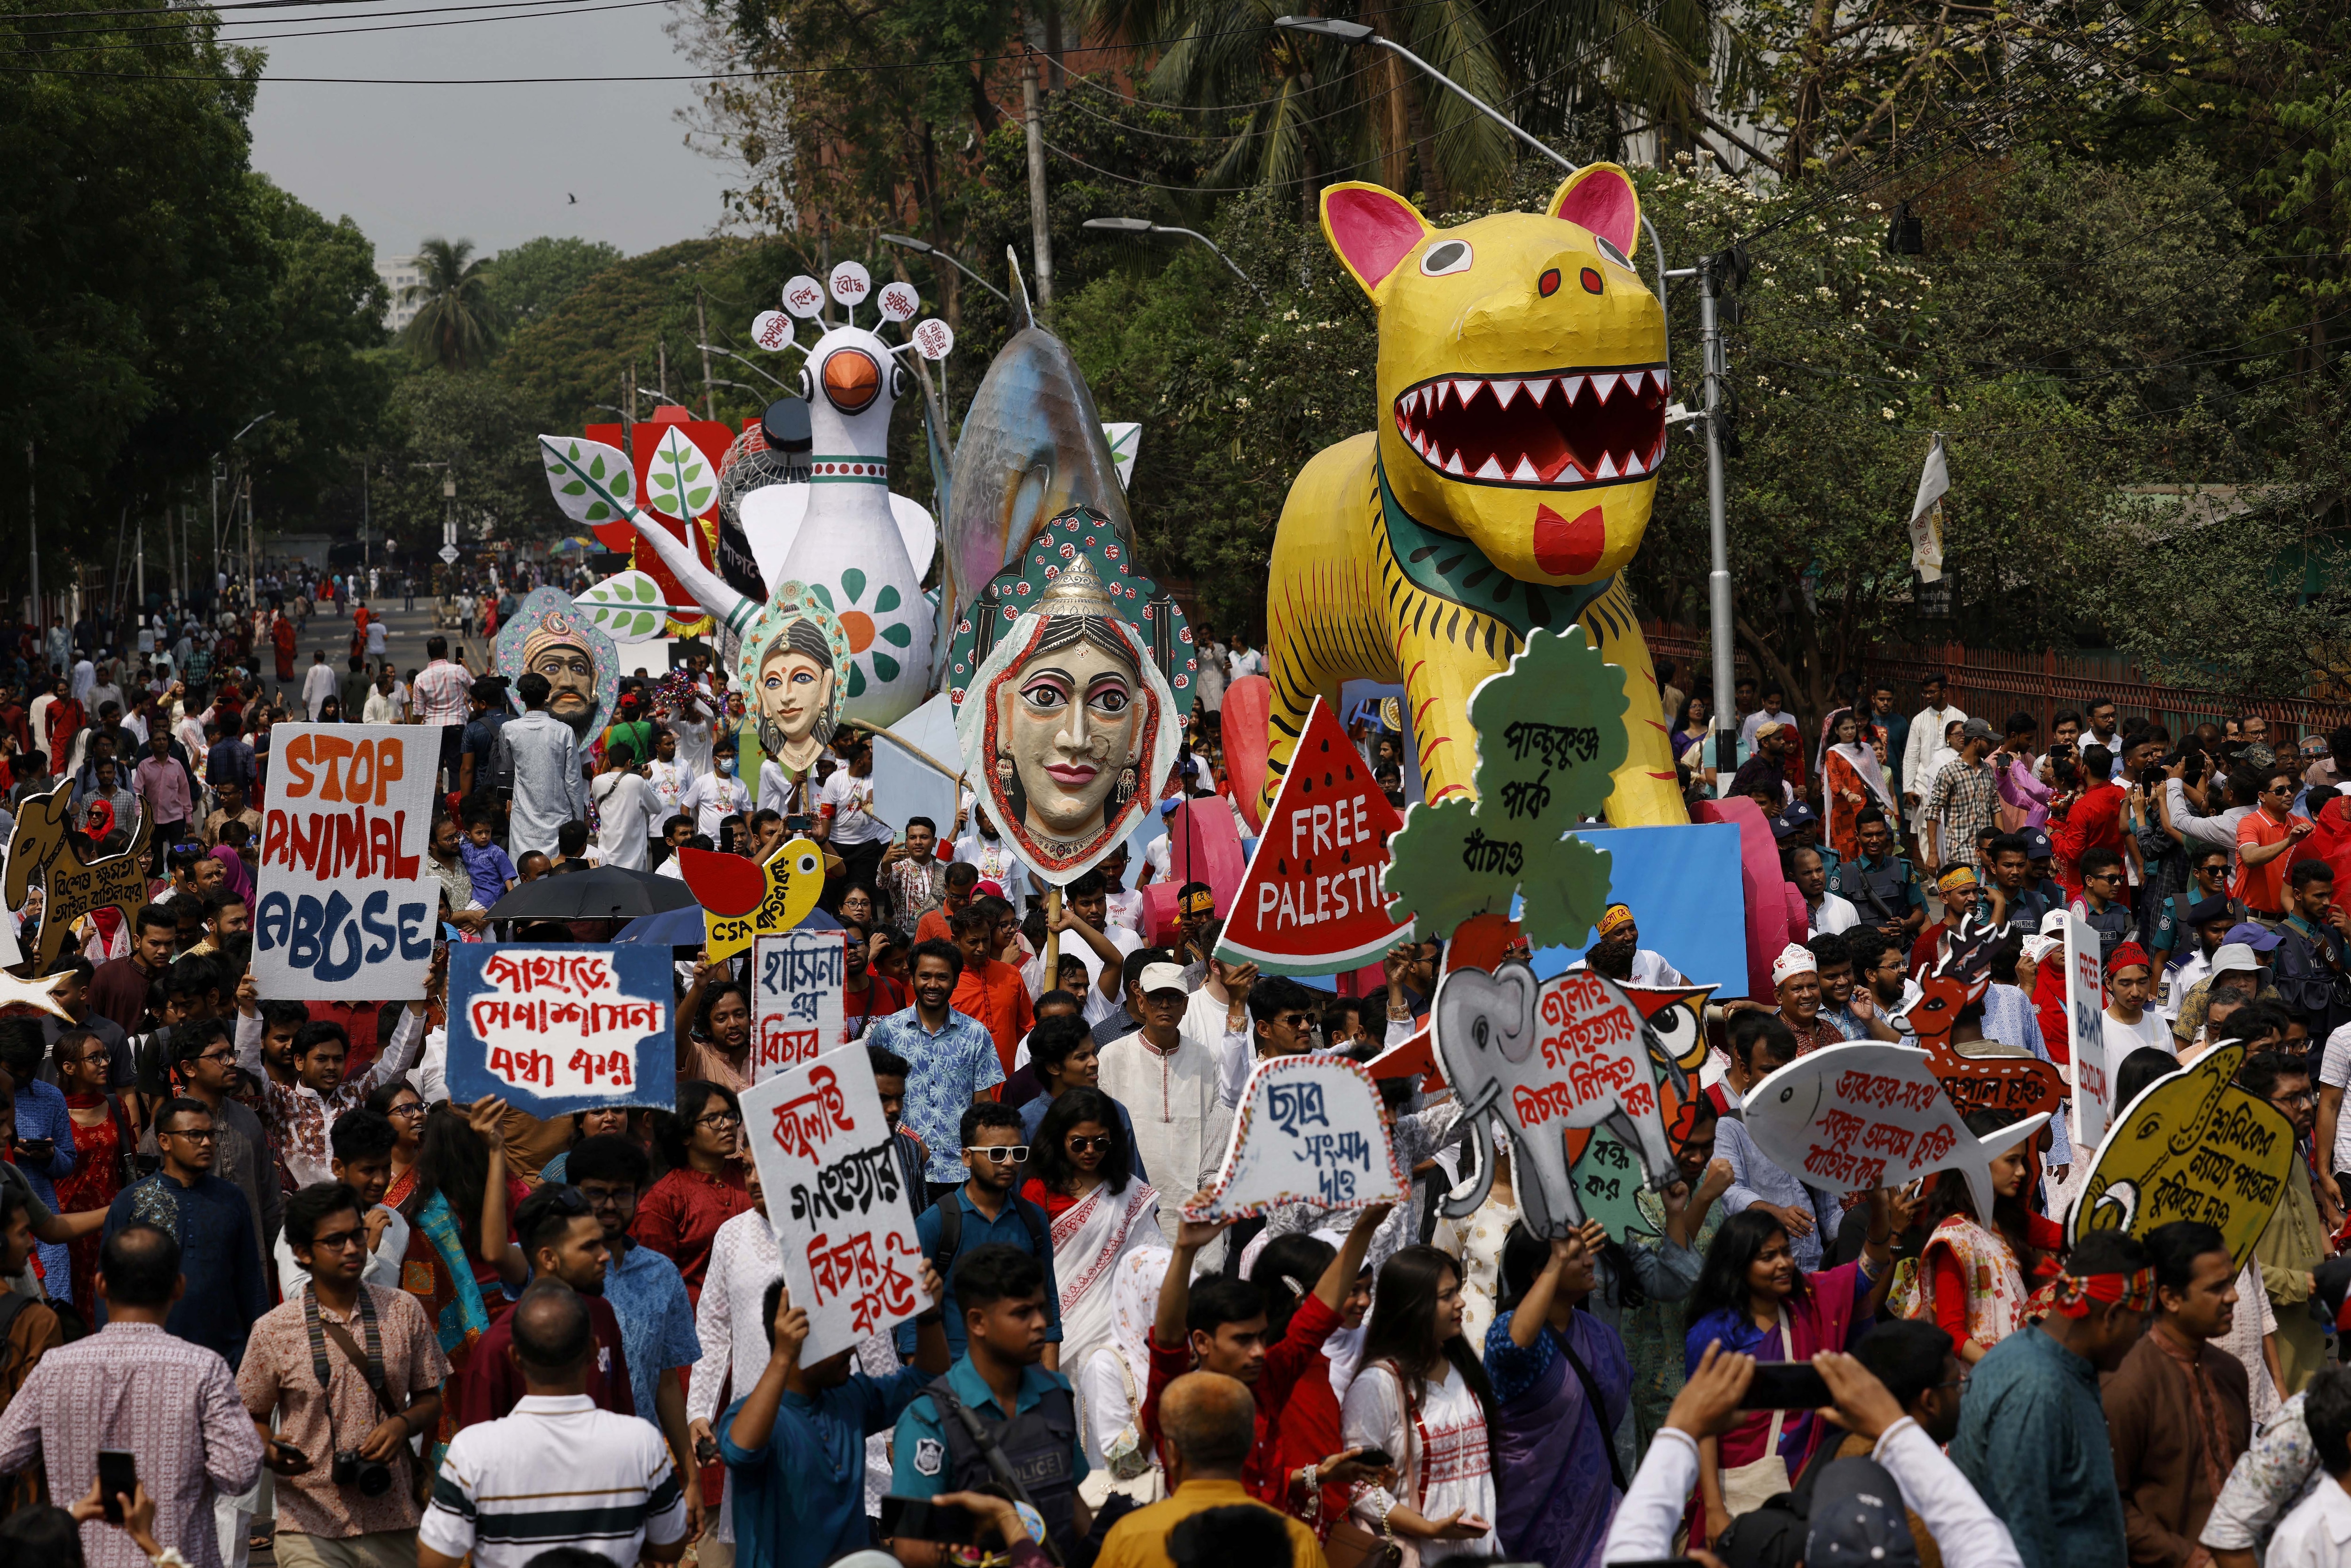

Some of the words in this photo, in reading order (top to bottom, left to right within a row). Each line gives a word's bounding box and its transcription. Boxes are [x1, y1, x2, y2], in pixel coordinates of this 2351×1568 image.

[790, 286, 820, 309] হিন্দু
[835, 275, 865, 294] বৌদ্ধ
[759, 314, 789, 348] মুসলিম
[286, 733, 403, 806] STOP
[1500, 769, 1551, 820] পার্ক
[262, 806, 420, 881] ANIMAL
[1292, 795, 1370, 859] FREE
[770, 857, 790, 884] কর
[1463, 827, 1524, 877] বাঁচাও
[54, 870, 91, 897] বিশেষ
[95, 858, 134, 884] ক্ষমতা
[1257, 860, 1389, 931] PALESTI
[52, 896, 87, 923] আইন
[91, 882, 123, 907] বাতিল
[123, 881, 142, 903] কর
[756, 886, 788, 930] বাতিল
[256, 890, 431, 982] ABUSE
[712, 920, 753, 942] CSA
[487, 955, 610, 998] পাহাড়ে
[762, 933, 843, 994] হাসিনা
[2079, 952, 2099, 990] FREE
[787, 991, 828, 1022] এর
[1541, 970, 1610, 1028] জুলাই
[760, 1013, 819, 1066] বিচার
[1540, 1005, 1635, 1069] গণহত্যার
[2077, 1000, 2104, 1049] BAWM
[490, 1047, 553, 1087] বন্ধ
[568, 1048, 632, 1086] কর
[2005, 1070, 2046, 1106] চুক্তি
[1267, 1082, 1329, 1137] ছাত্র
[1513, 1081, 1574, 1128] বিচার
[1569, 1055, 1635, 1106] নিশ্চিত
[1620, 1083, 1655, 1117] কর
[1835, 1070, 1900, 1109] ভারতের
[1896, 1080, 1942, 1113] সাথে
[772, 1065, 854, 1165] জুলাই
[2205, 1101, 2277, 1158] শ্রমিকের
[1293, 1131, 1370, 1172] সংসদ
[1593, 1140, 1629, 1169] বন্ধ
[1816, 1108, 1866, 1150] সকল
[1862, 1121, 1915, 1159] অসম
[1908, 1124, 1957, 1170] চুক্তি
[1319, 1169, 1356, 1205] দাও
[1585, 1175, 1620, 1200] কর
[1804, 1140, 1854, 1176] বাতিল
[1854, 1157, 1887, 1189] কর
[2233, 1163, 2281, 1207] পাওনা
[2149, 1169, 2204, 1221] বুঝিয়ে
[2203, 1197, 2230, 1228] দাও
[806, 1230, 879, 1307] বিচার
